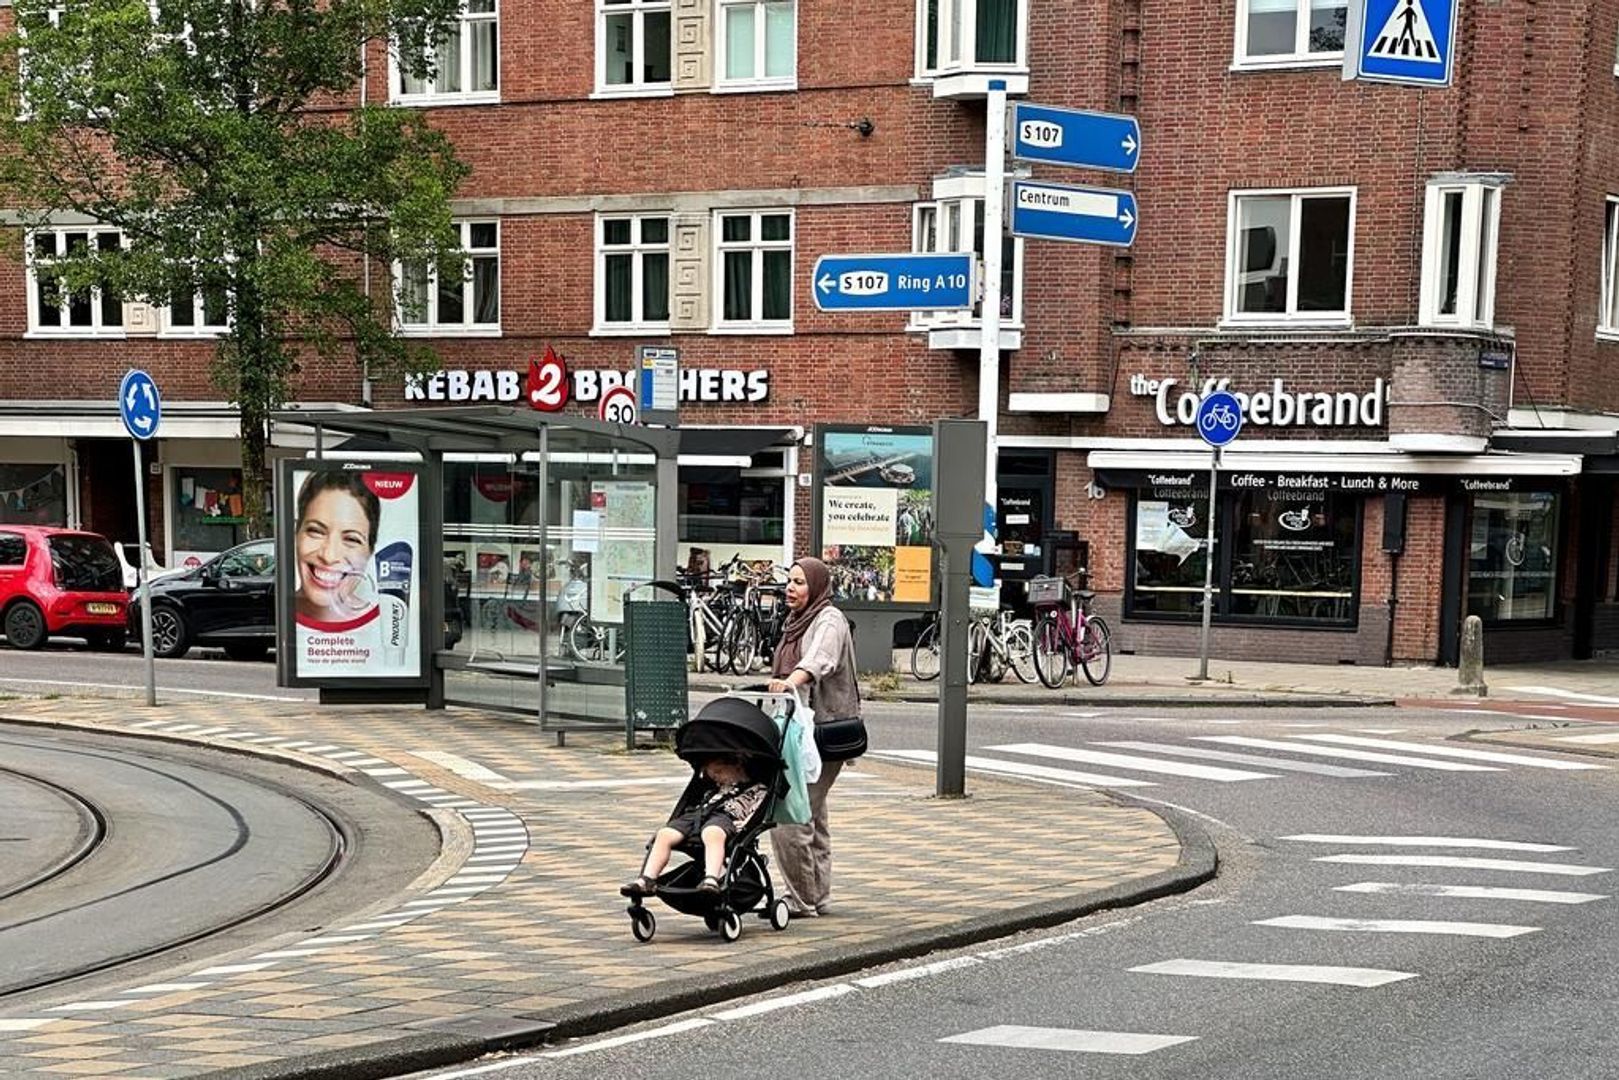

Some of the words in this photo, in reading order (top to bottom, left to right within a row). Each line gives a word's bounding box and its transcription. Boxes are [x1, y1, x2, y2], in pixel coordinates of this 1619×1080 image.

[1025, 127, 1031, 139] S
[1034, 127, 1059, 143] 107
[1019, 189, 1070, 207] Centrum
[844, 276, 852, 289] S
[857, 276, 884, 289] 107
[898, 275, 930, 293] Ring
[404, 370, 520, 401] KEBAB
[531, 363, 561, 404] 2
[574, 369, 768, 401] BRHERS
[1130, 374, 1158, 395] the
[608, 403, 634, 424] 30
[1231, 474, 1265, 487] Coffee
[1277, 474, 1329, 488] Breakfast
[1341, 475, 1374, 489] Lunch
[1379, 478, 1387, 489] &
[1391, 477, 1419, 490] More
[829, 500, 842, 509] We
[845, 502, 876, 510] create,
[828, 514, 845, 522] you
[847, 513, 890, 522] celebrate
[380, 561, 391, 577] B
[307, 636, 355, 646] Complete
[307, 647, 370, 658] Bescherming
